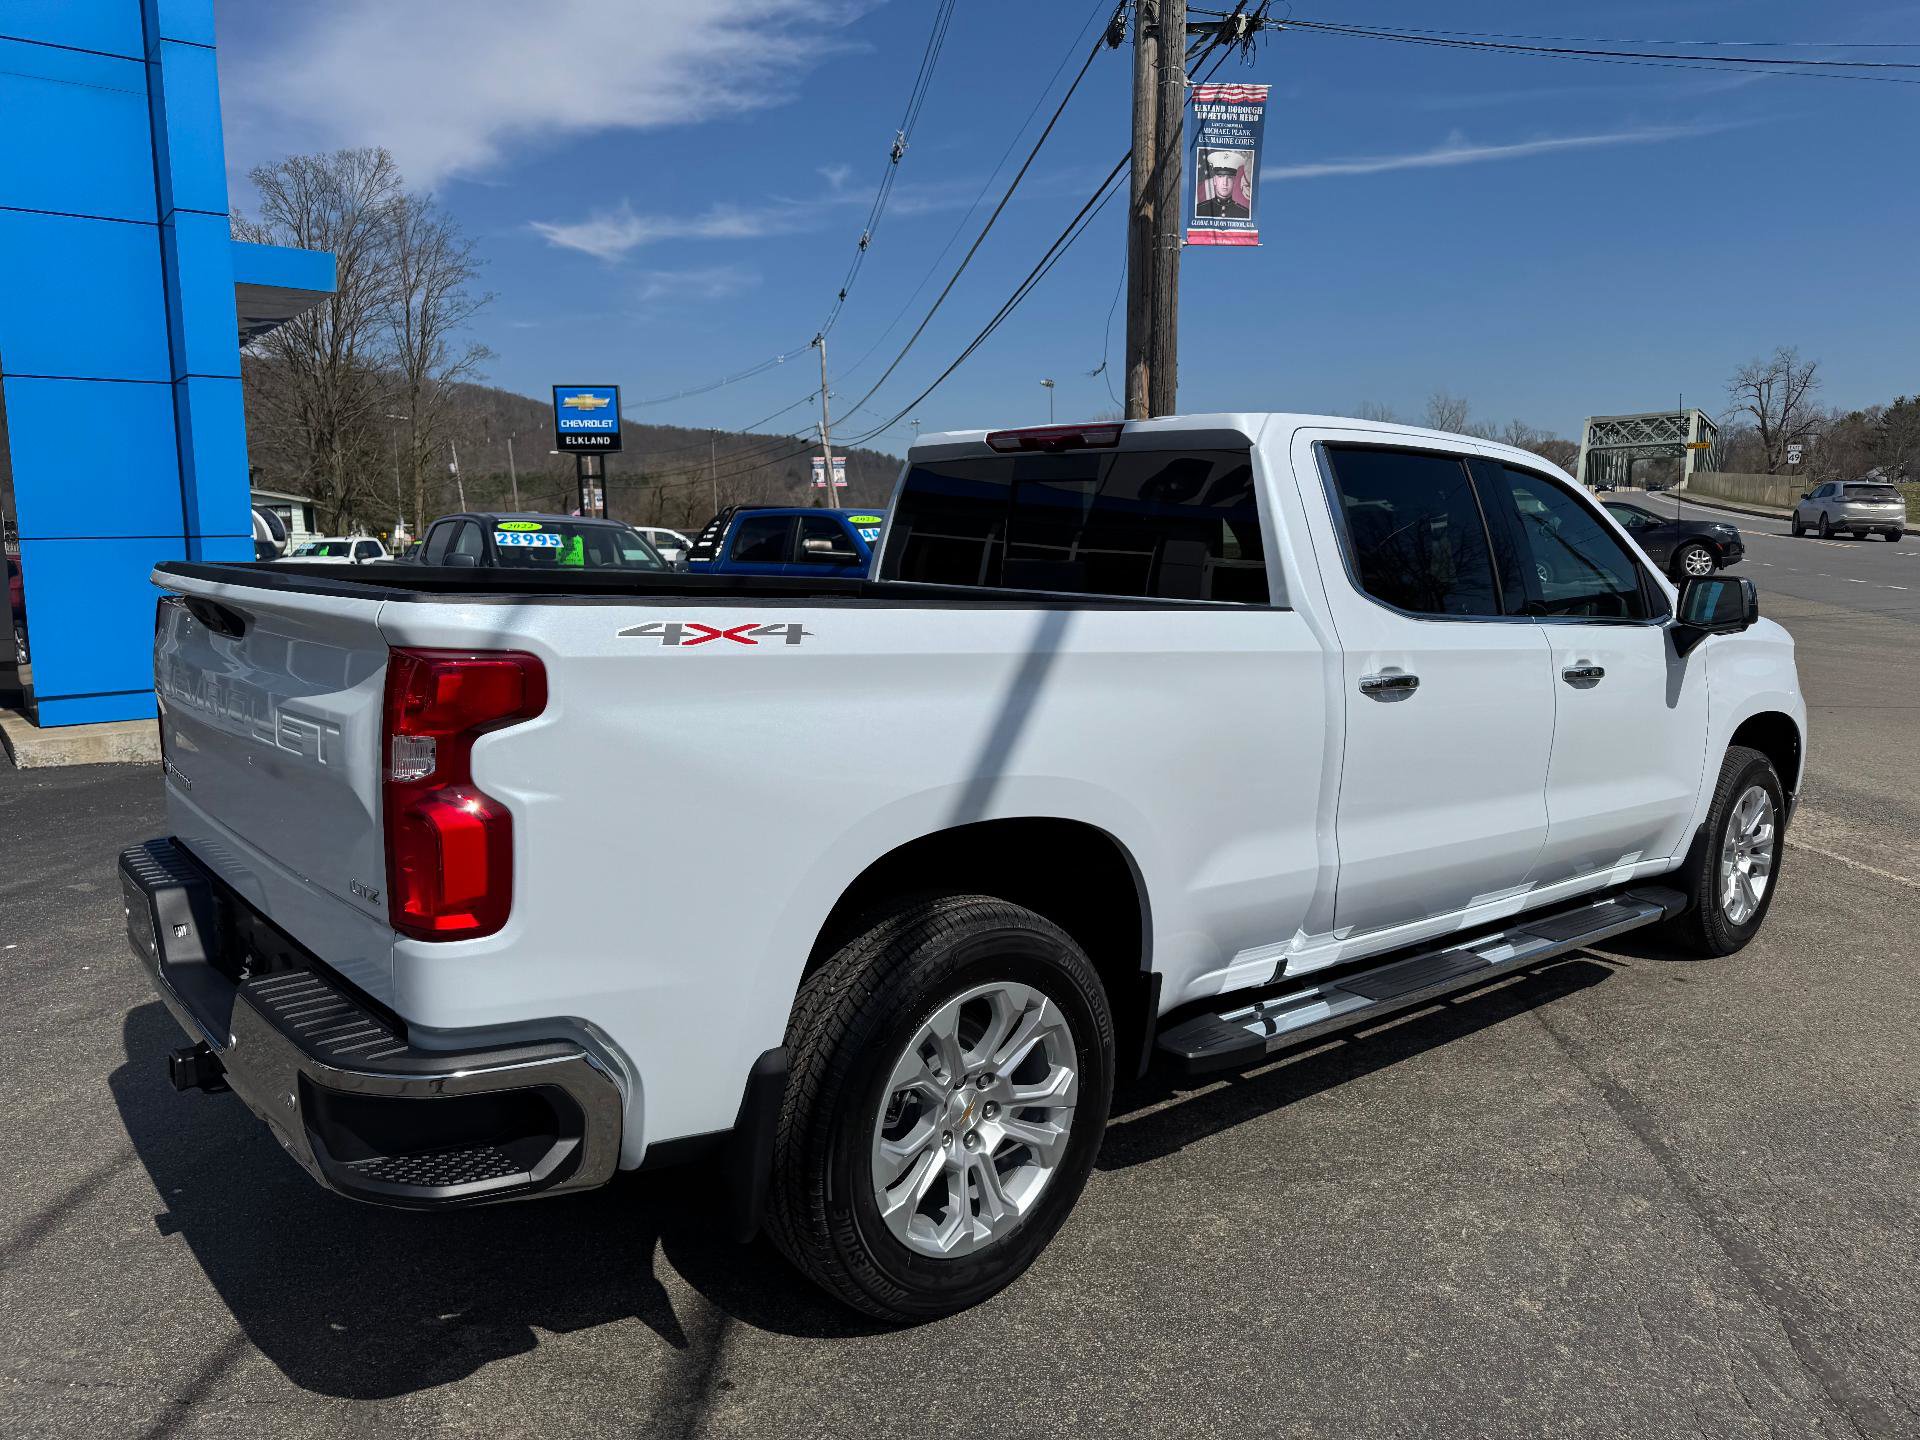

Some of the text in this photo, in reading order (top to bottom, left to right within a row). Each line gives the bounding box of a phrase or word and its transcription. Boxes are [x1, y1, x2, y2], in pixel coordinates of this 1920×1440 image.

[1194, 104, 1263, 114] ELKLAND BOROUGH
[1197, 112, 1238, 120] HOMETOWN
[1203, 127, 1231, 135] MICHAEL
[1210, 136, 1234, 145] MARINE
[1234, 138, 1255, 146] CORPS
[560, 419, 614, 428] CHEVROLET
[565, 436, 611, 445] ELKLAND
[497, 532, 561, 546] 28995
[157, 660, 340, 765] EVROLET
[350, 878, 381, 905] LTZ
